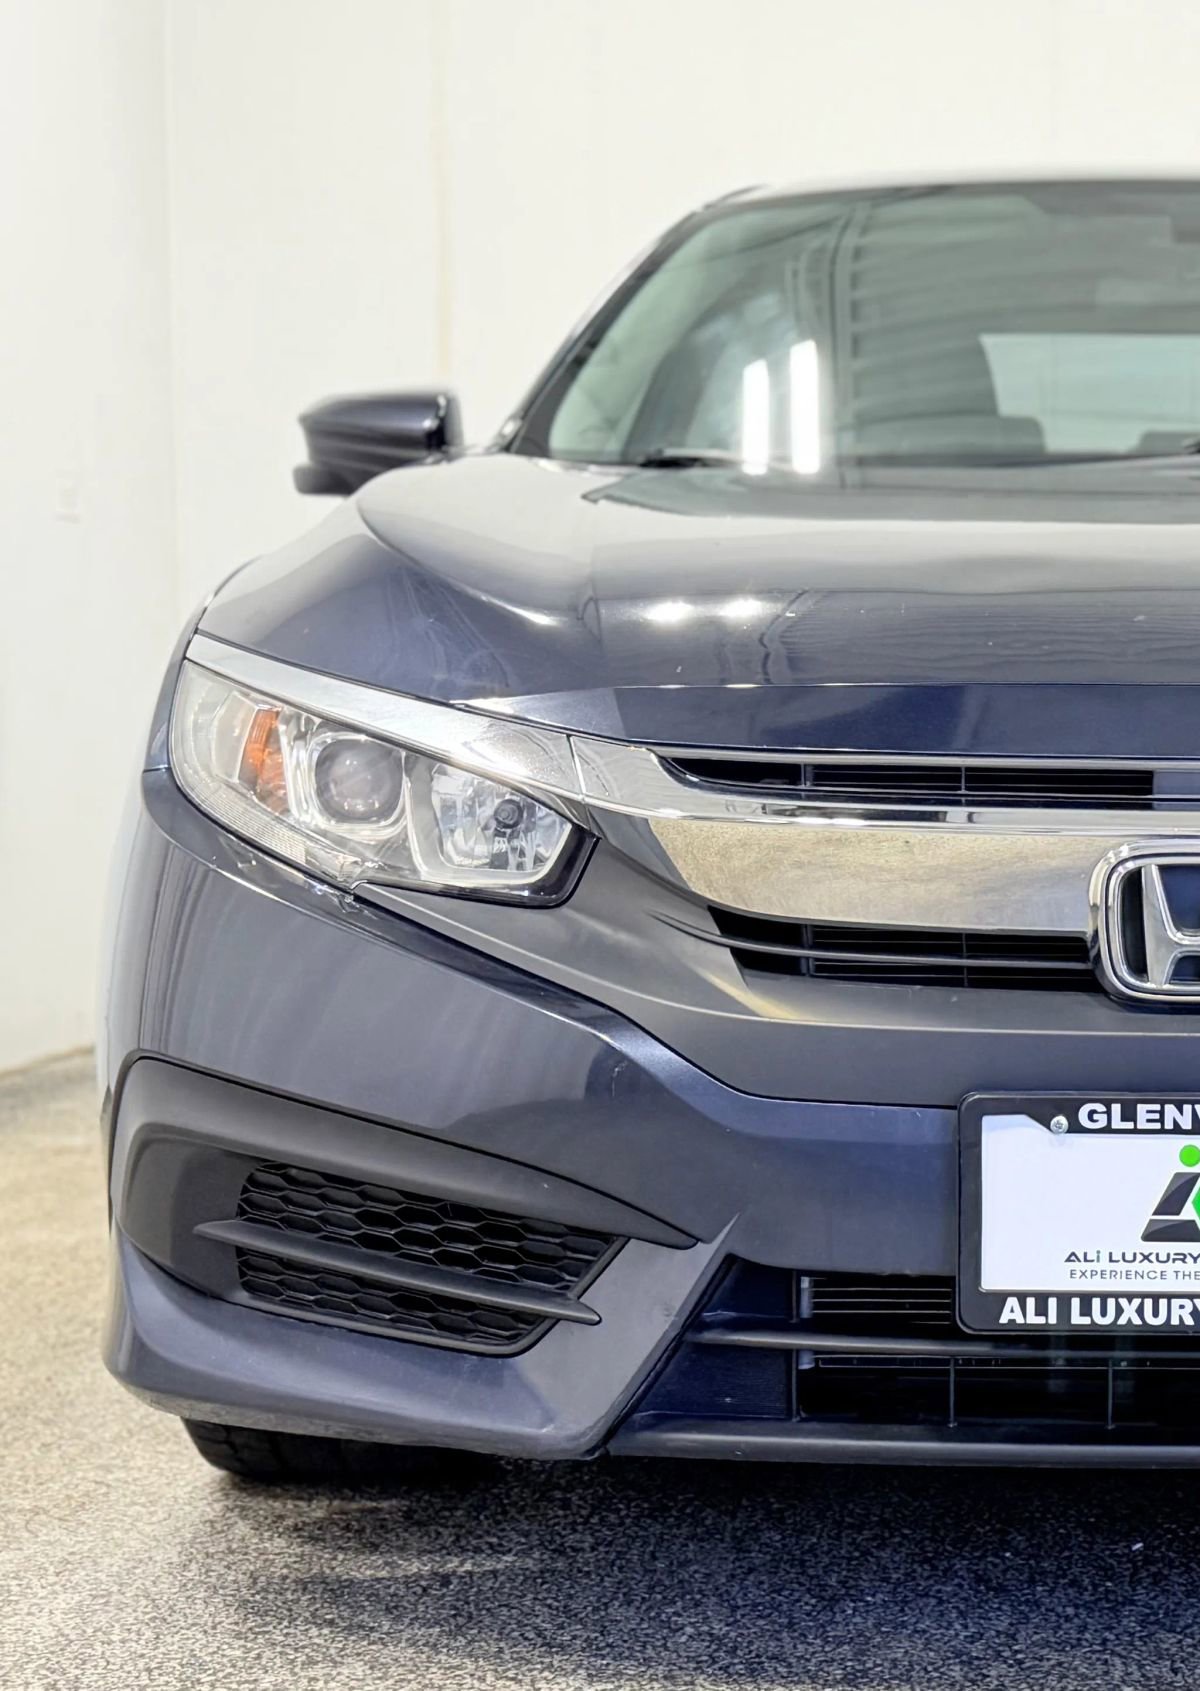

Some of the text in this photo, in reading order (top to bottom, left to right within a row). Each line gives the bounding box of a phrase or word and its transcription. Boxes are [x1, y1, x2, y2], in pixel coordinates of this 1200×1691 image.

[1069, 1269, 1168, 1280] EXPERIENCE
[1173, 1270, 1200, 1281] THE
[999, 1297, 1057, 1325] ALI
